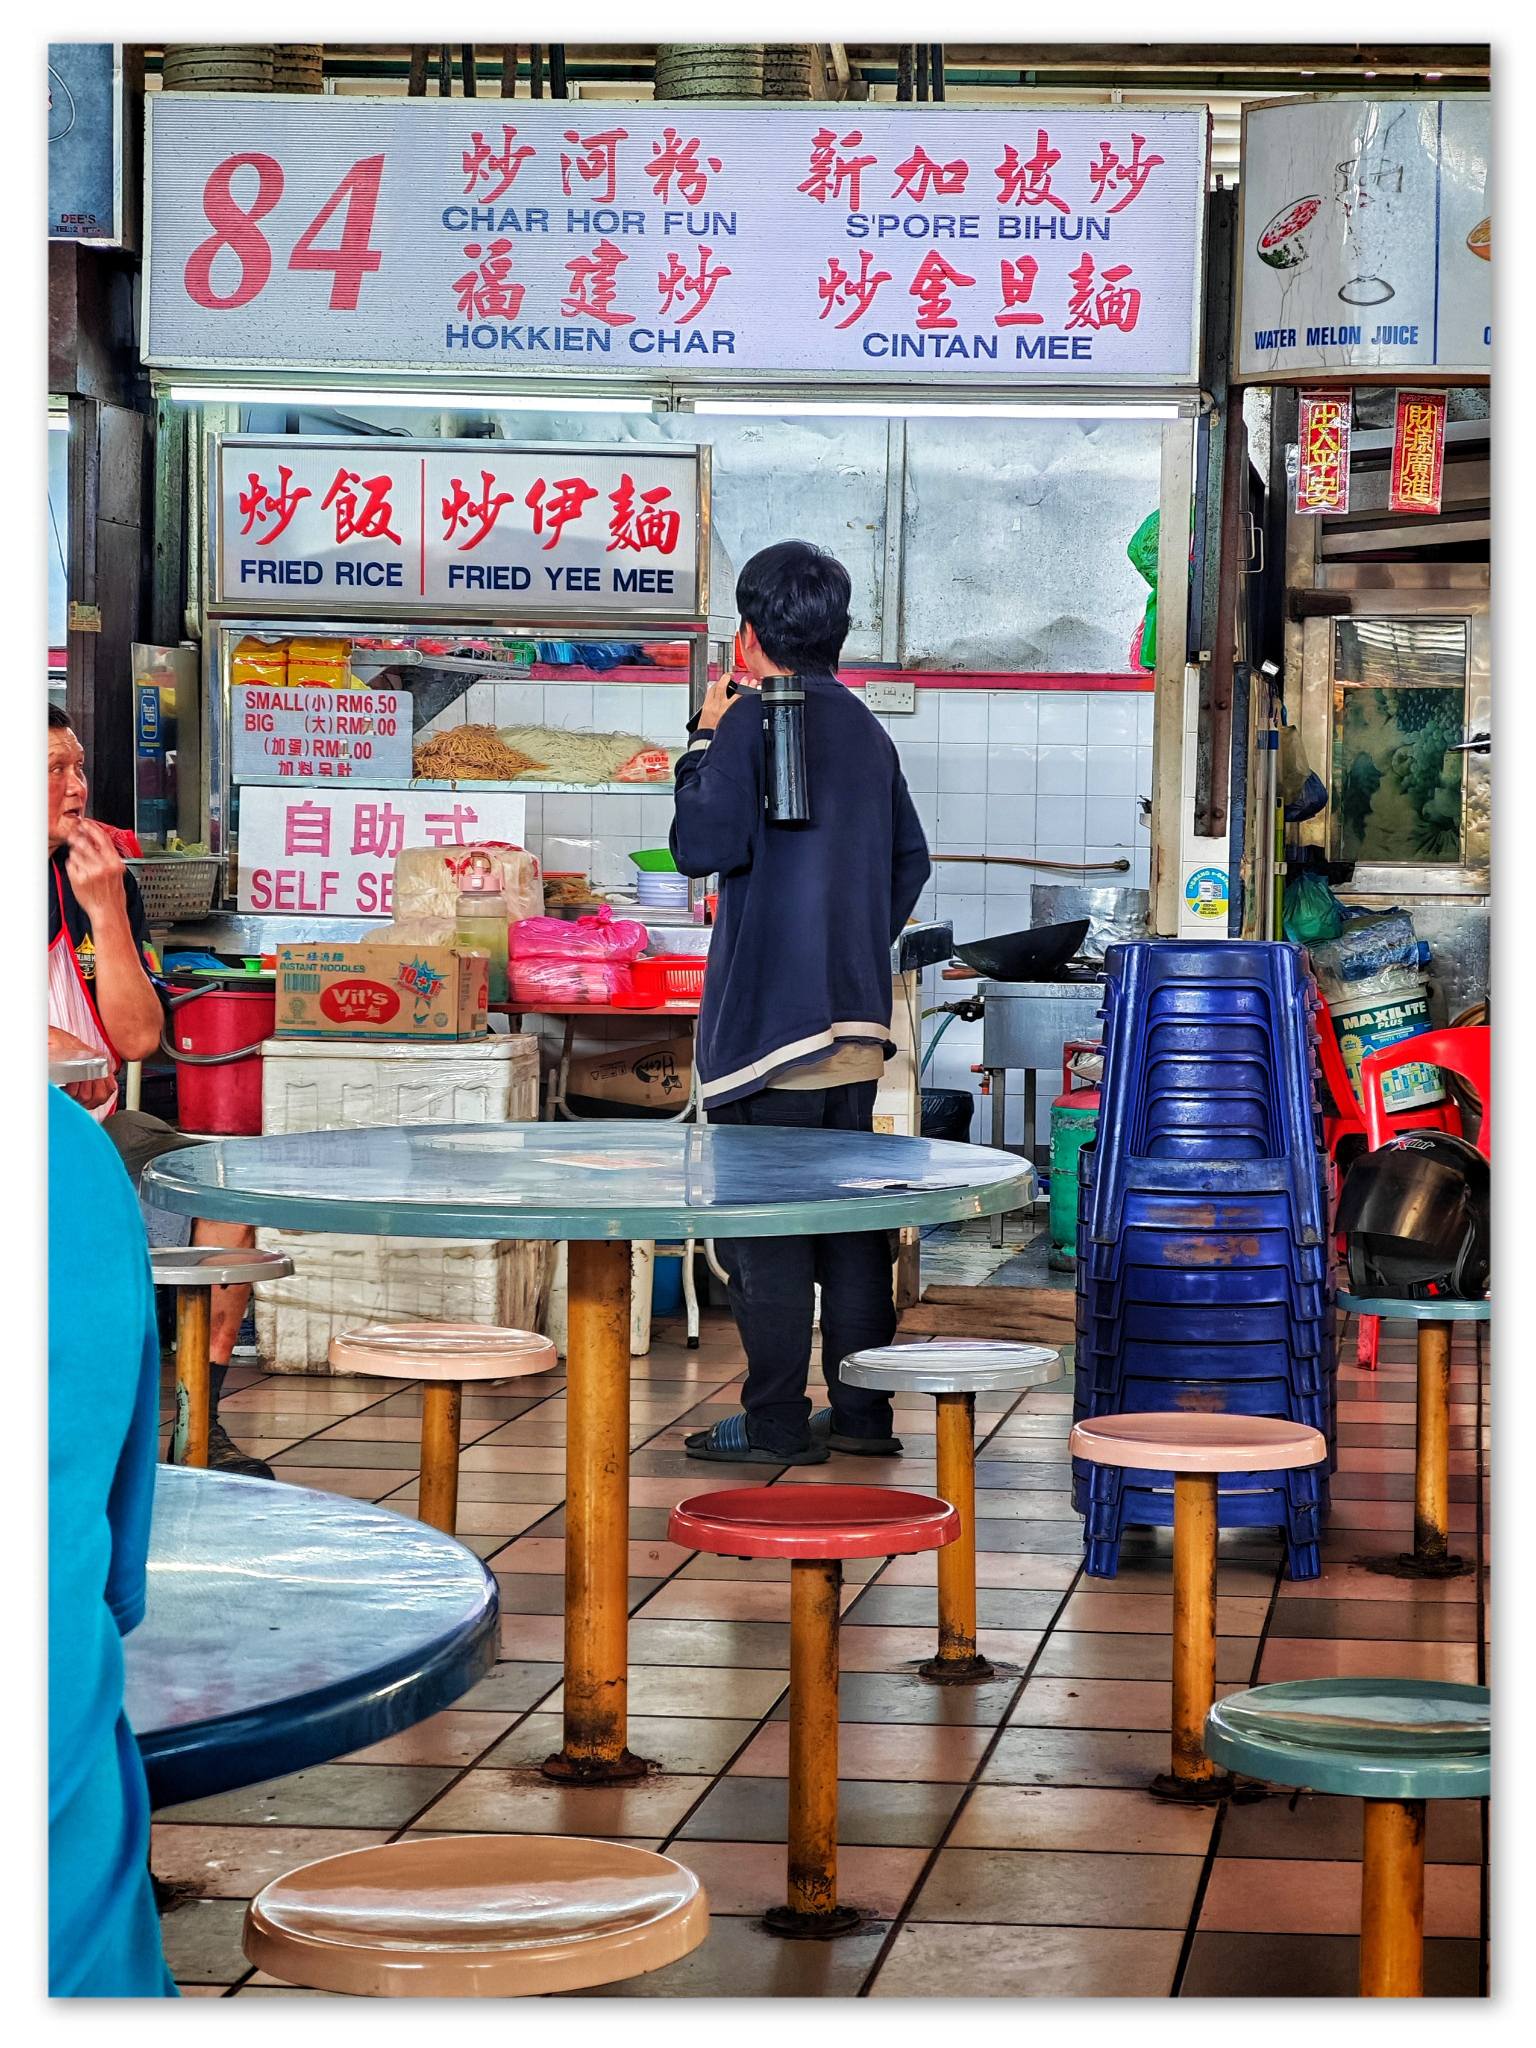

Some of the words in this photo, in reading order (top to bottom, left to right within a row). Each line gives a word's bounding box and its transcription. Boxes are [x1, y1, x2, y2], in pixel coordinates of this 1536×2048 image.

[462, 123, 723, 205] 炒河粉
[796, 127, 1166, 215] 新加坡炒
[183, 152, 386, 311] 84
[442, 205, 549, 232] CHAR
[567, 208, 646, 235] HOR
[664, 211, 737, 236] FUN
[845, 213, 980, 239] S'PORE
[998, 215, 1111, 241] BIHUN
[452, 238, 732, 327] 福建炒
[446, 324, 611, 352] HOKKIEN
[628, 328, 736, 354] CHAR
[862, 332, 998, 359] CINTAN
[1015, 335, 1093, 360] MEE
[1254, 328, 1297, 350] WATER
[1306, 326, 1361, 346] MELON
[1371, 325, 1419, 345] JUICE
[1308, 402, 1341, 503] 出入平安
[1400, 404, 1436, 503] 財源廣進
[239, 465, 402, 546] 炒飯
[240, 559, 323, 585] FRIED
[335, 561, 403, 587] RICE
[448, 564, 531, 589] FRIED
[544, 566, 600, 591] YEE
[613, 568, 674, 594] MEE
[337, 694, 397, 714] RM6.50
[245, 714, 274, 732] BIG
[304, 715, 333, 734] (大)
[284, 800, 479, 859] 自助式
[250, 868, 340, 911] SELF
[280, 962, 318, 971] INSTANT
[320, 964, 366, 973] NOODLES
[332, 988, 389, 1005] Vit's
[1342, 1000, 1427, 1031] MAXILITE
[1377, 1017, 1404, 1030] PLUS
